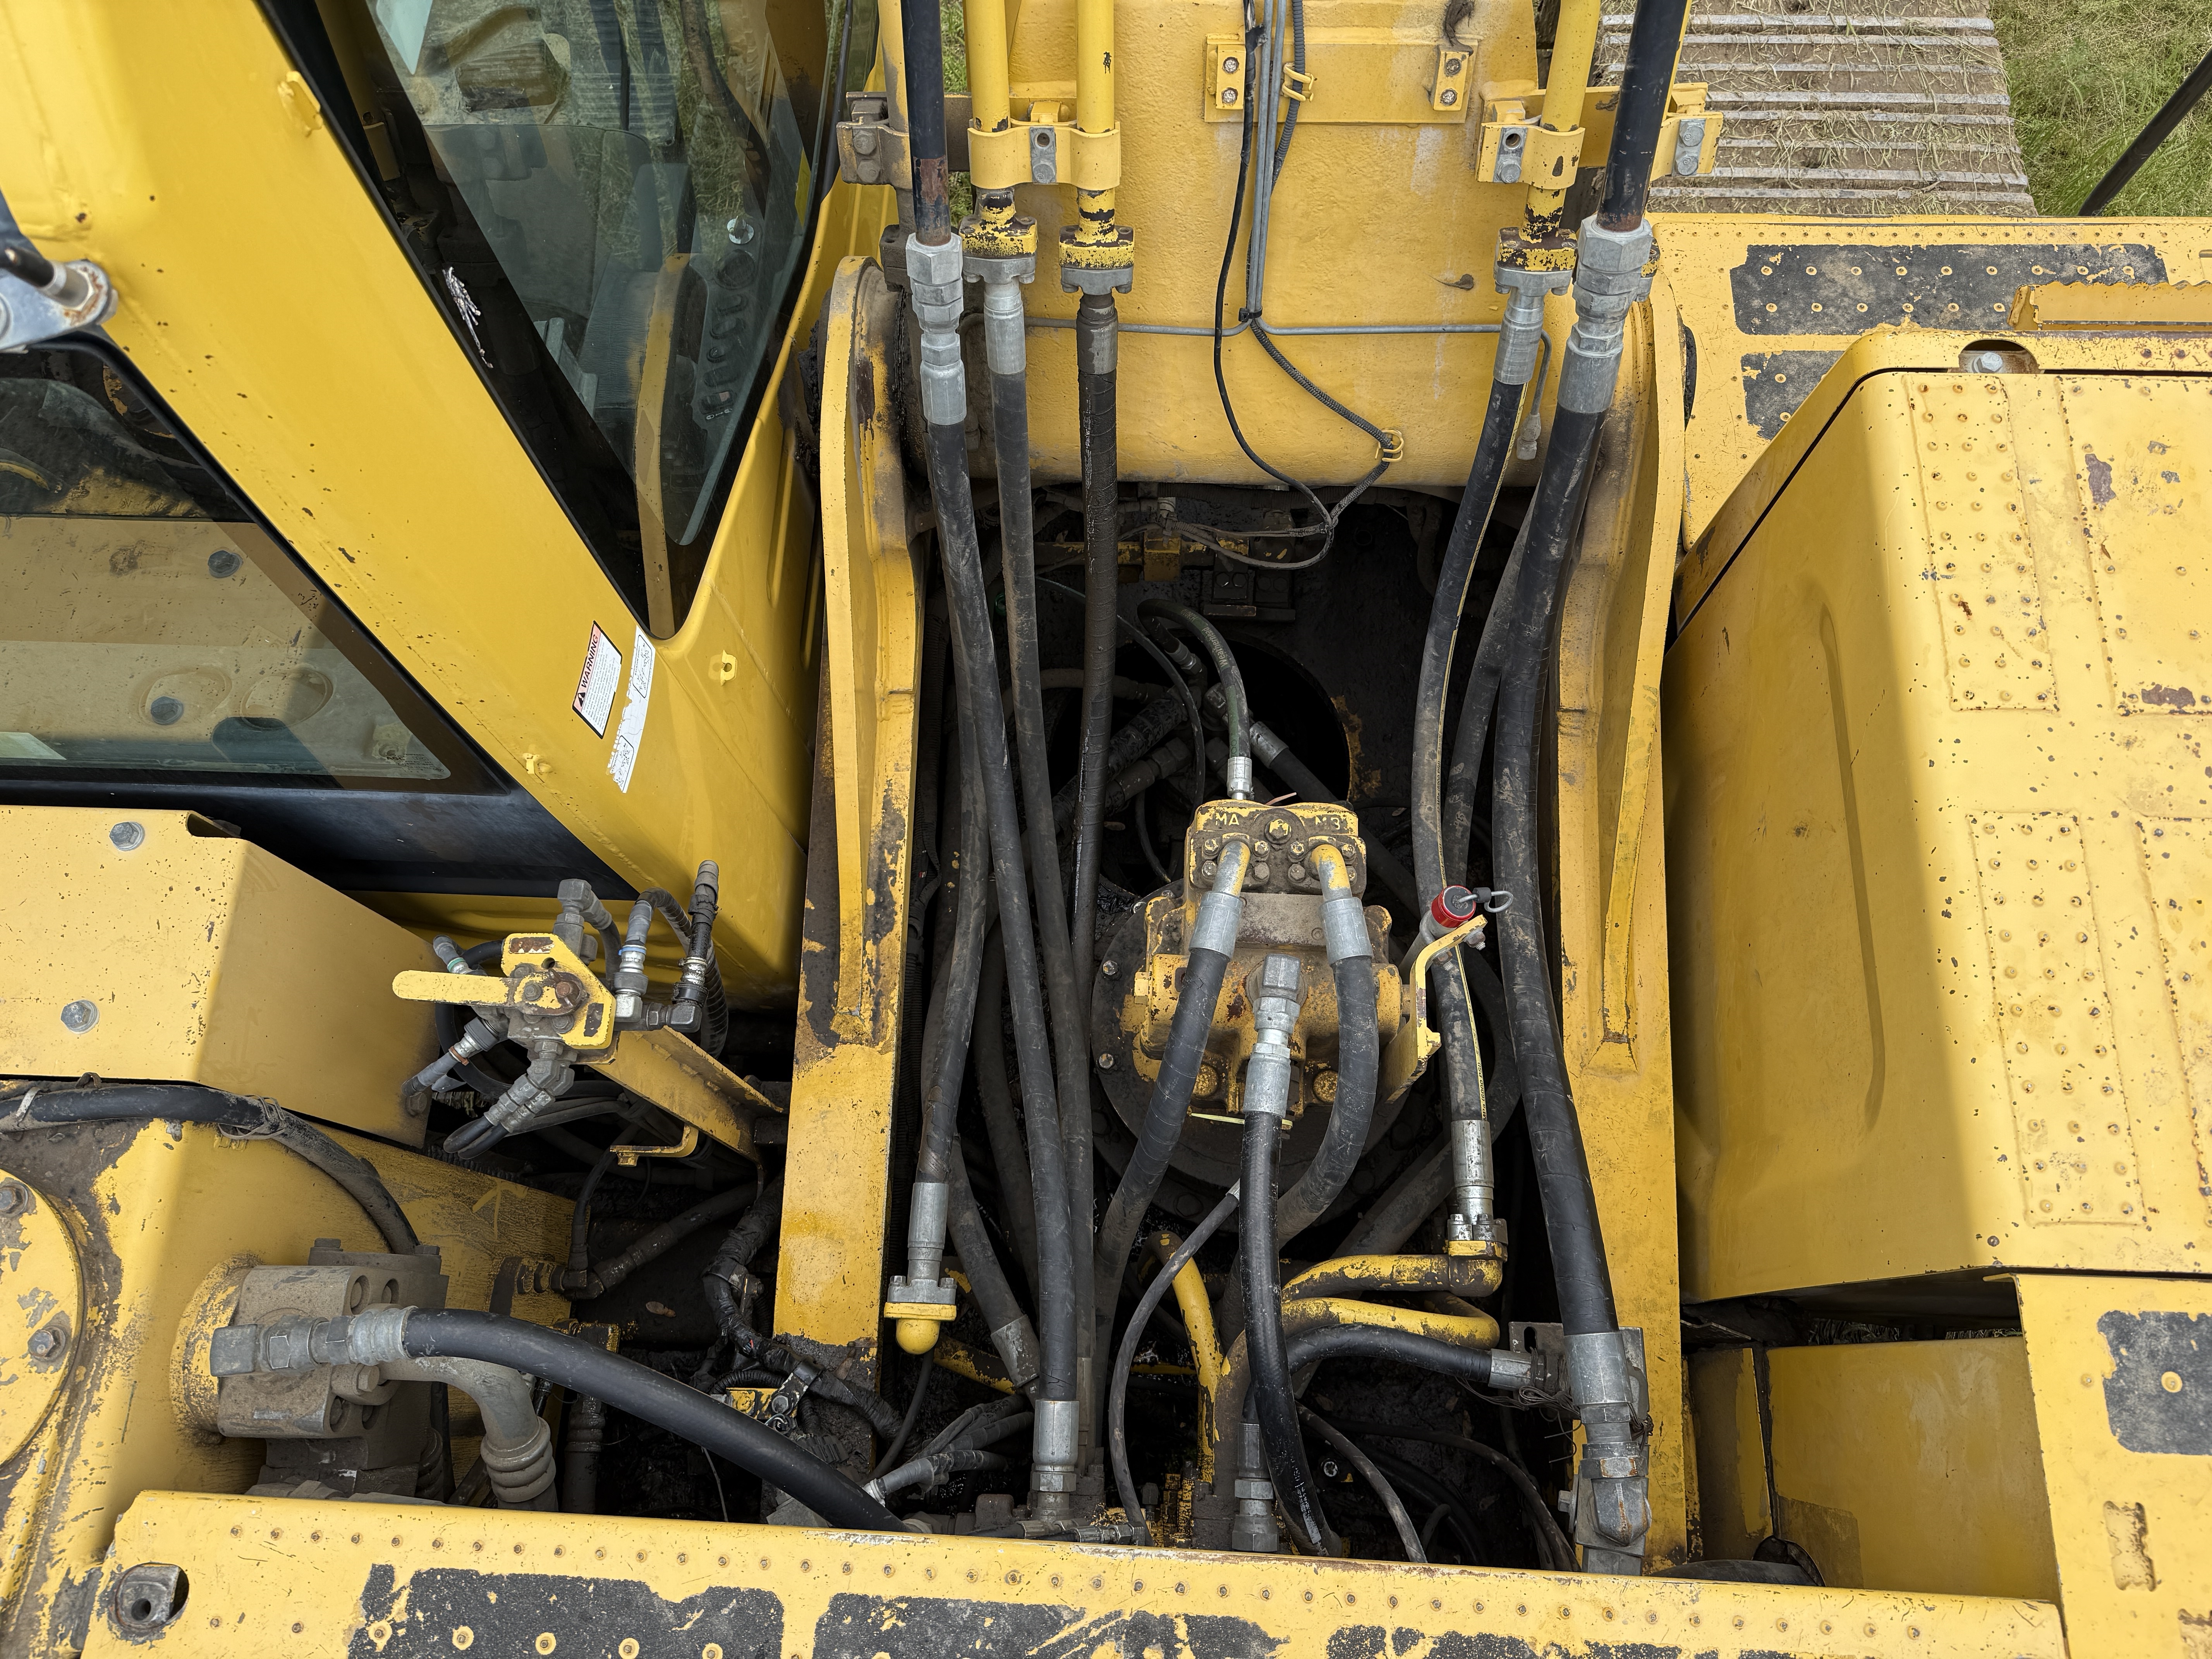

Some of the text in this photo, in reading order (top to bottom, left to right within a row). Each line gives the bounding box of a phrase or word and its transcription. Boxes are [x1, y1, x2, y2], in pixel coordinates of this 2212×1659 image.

[581, 634, 598, 688] WARNING
[1202, 627, 1228, 668] Weatherhead
[1216, 813, 1240, 826] MA
